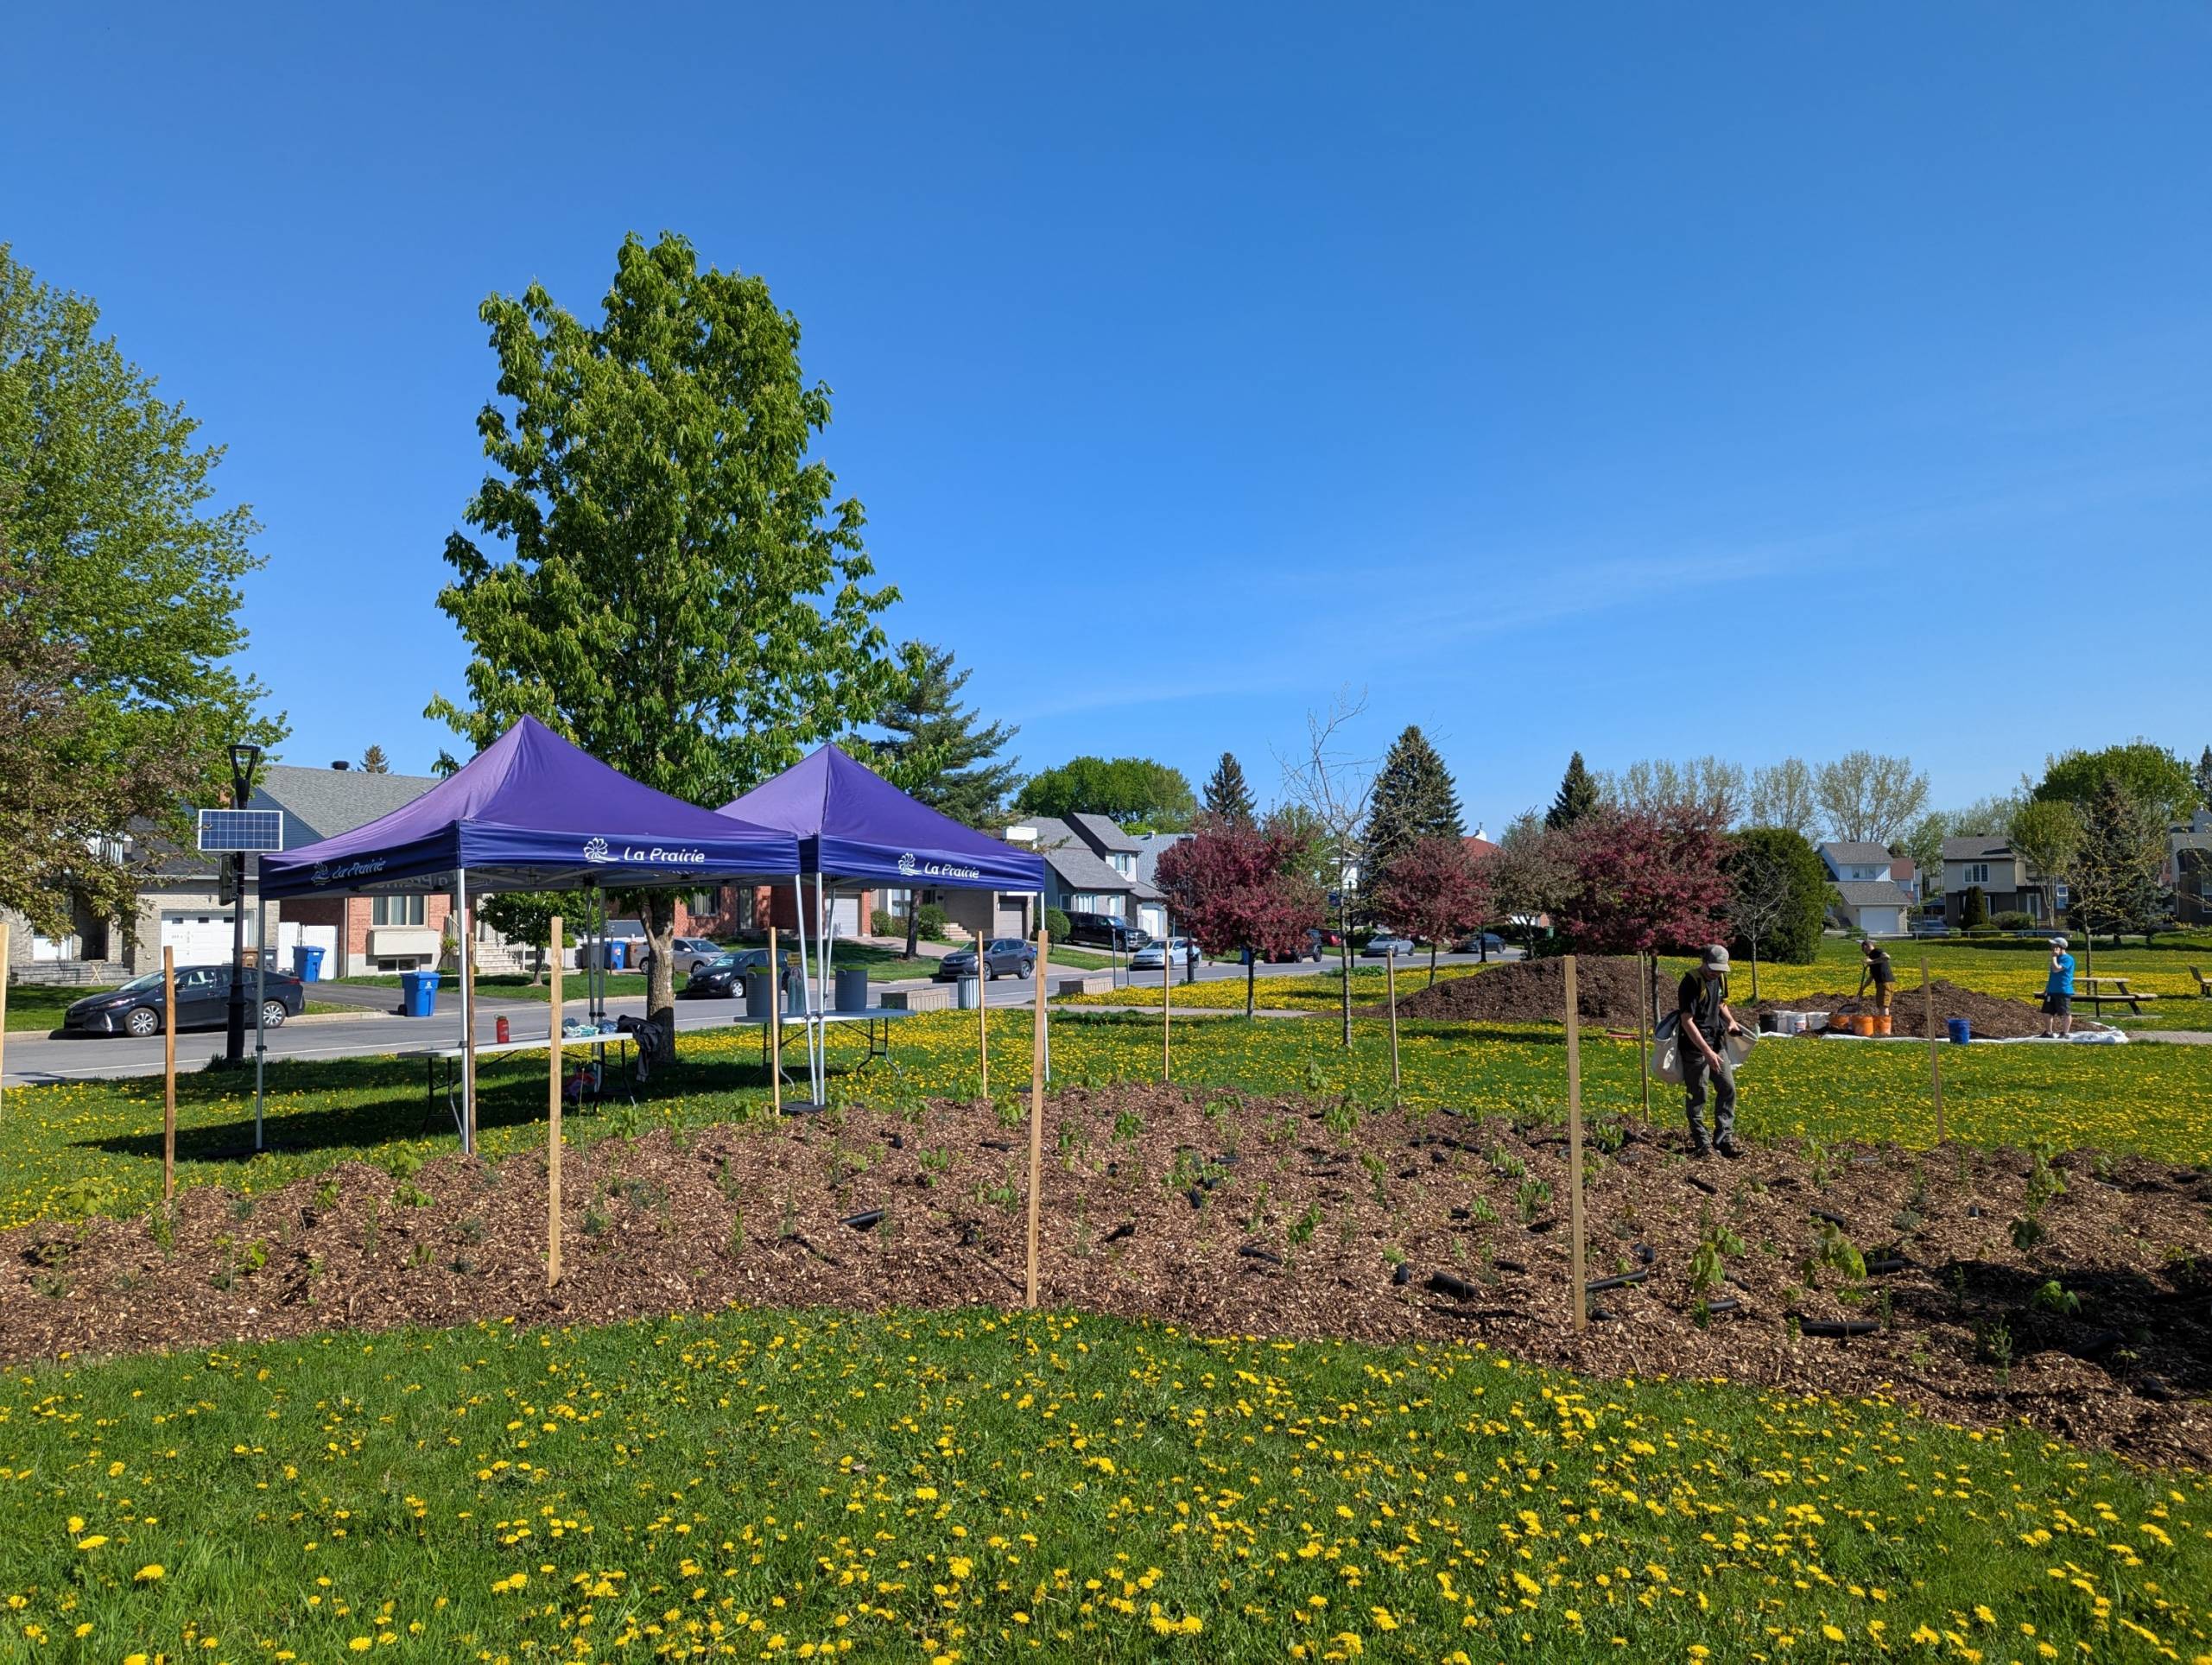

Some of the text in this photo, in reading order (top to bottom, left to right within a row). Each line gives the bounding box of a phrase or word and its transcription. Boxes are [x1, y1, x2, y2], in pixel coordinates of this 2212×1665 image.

[624, 846, 706, 863] La Prairie
[332, 858, 386, 879] La Prairie
[924, 862, 980, 879] La Prairie
